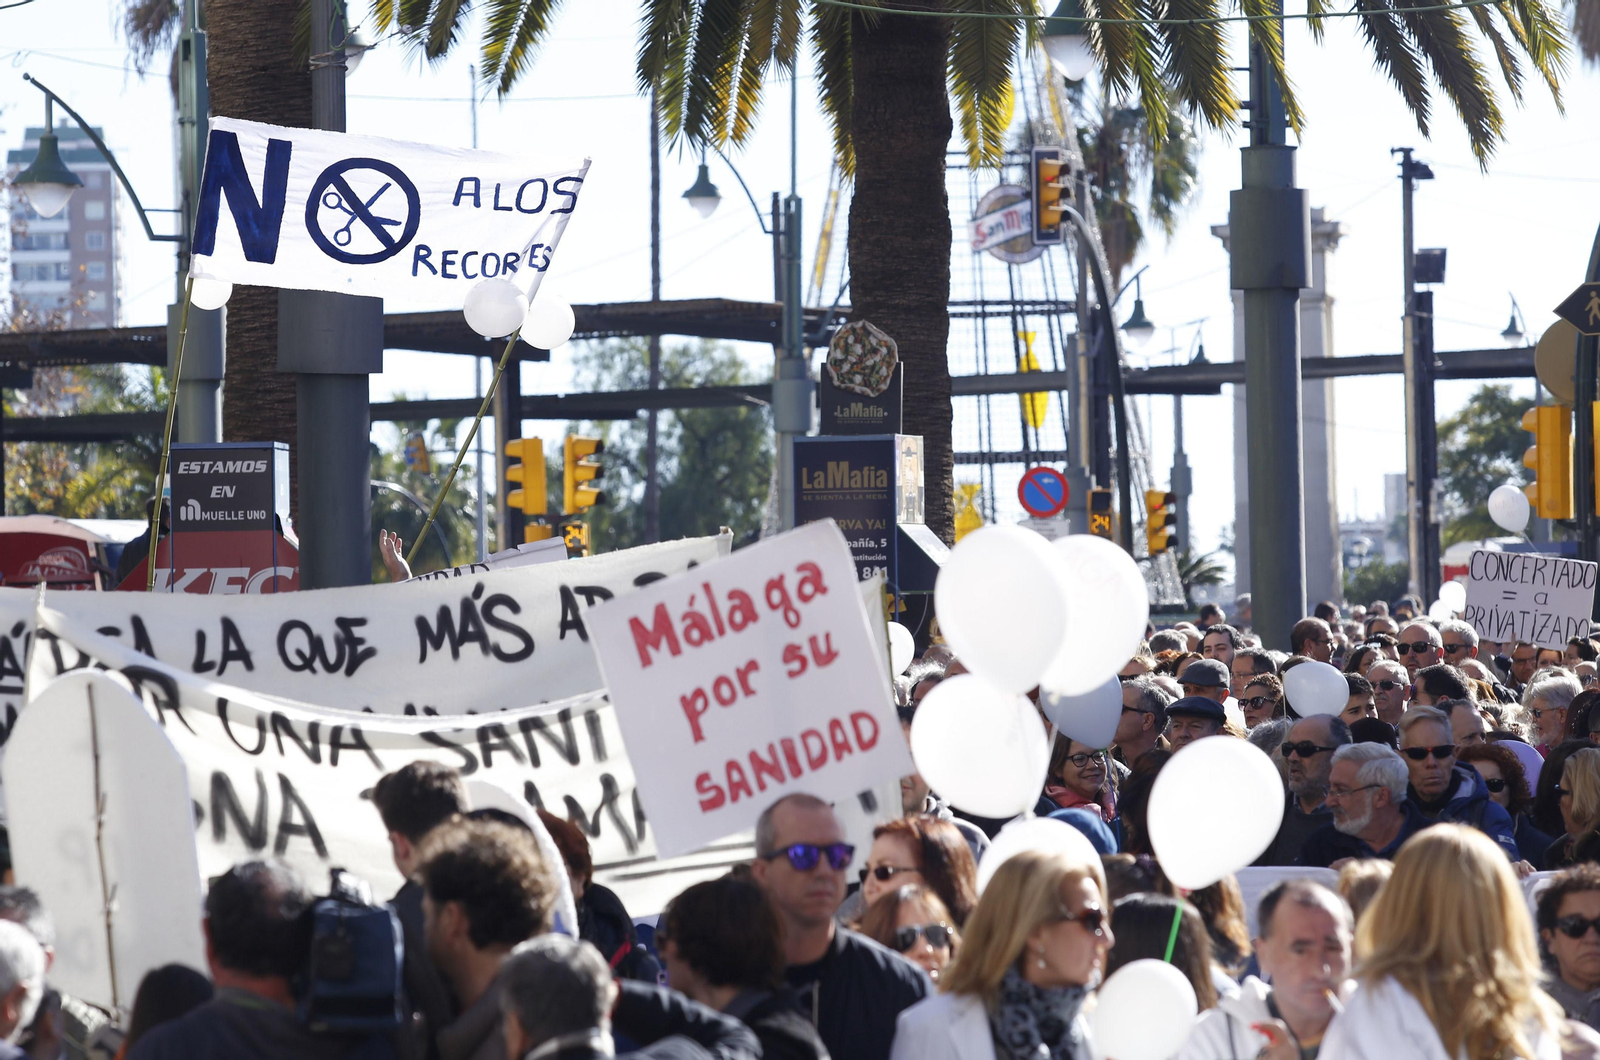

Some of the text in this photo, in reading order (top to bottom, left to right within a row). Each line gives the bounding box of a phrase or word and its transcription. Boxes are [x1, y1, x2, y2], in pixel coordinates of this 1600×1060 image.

[411, 244, 552, 280] RECORES
[178, 460, 267, 474] ESTAMOS
[210, 485, 236, 498] EN
[201, 510, 267, 521] MUELLE UNO
[866, 519, 887, 530] YA!
[1091, 514, 1110, 533] 24
[880, 538, 888, 548] 5
[1470, 550, 1597, 590] CONCERTADO
[1534, 592, 1548, 605] a
[628, 560, 828, 669] Málaga
[192, 616, 255, 676] LA
[277, 617, 378, 677] QUE
[415, 582, 535, 663] MÁS
[679, 632, 839, 744] por su
[216, 696, 385, 770] UNA
[695, 710, 880, 814] SANIDAD
